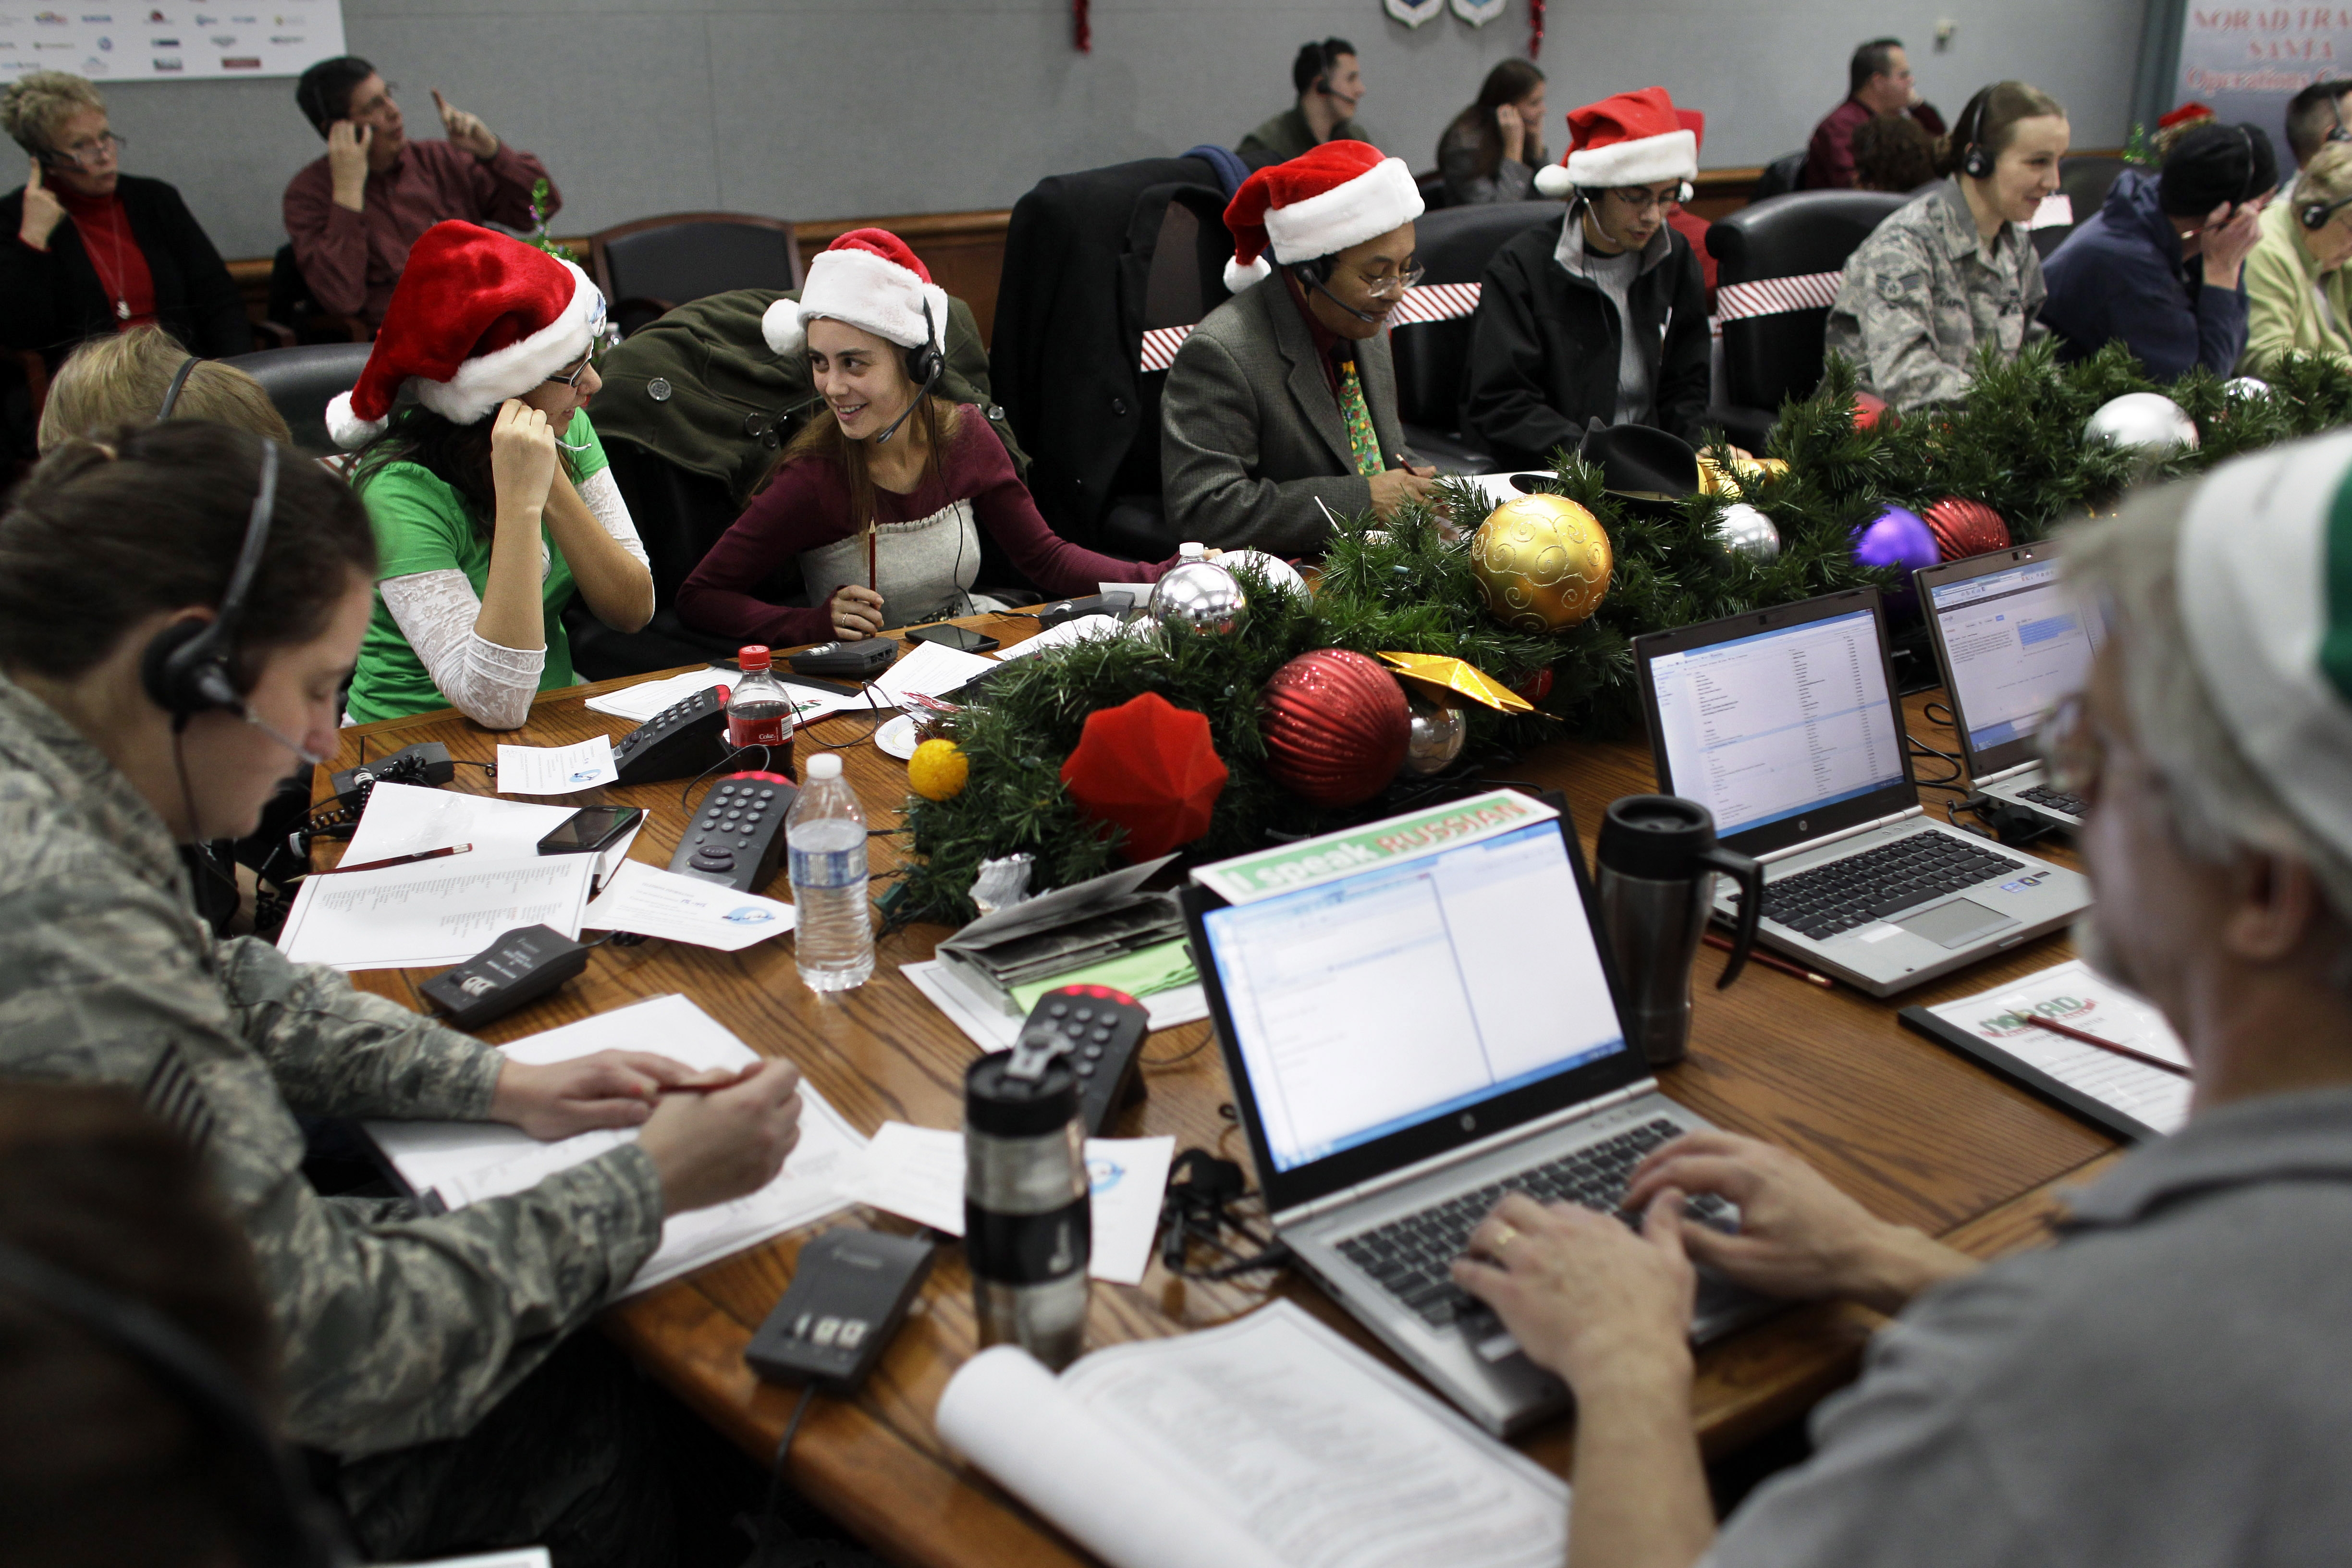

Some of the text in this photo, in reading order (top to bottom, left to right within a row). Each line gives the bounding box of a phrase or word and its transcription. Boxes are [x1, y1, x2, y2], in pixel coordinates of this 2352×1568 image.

[2194, 7, 2352, 29] NORAD TRA
[2249, 38, 2333, 59] SANTA
[1225, 801, 1527, 894] I speak RUSSIAN
